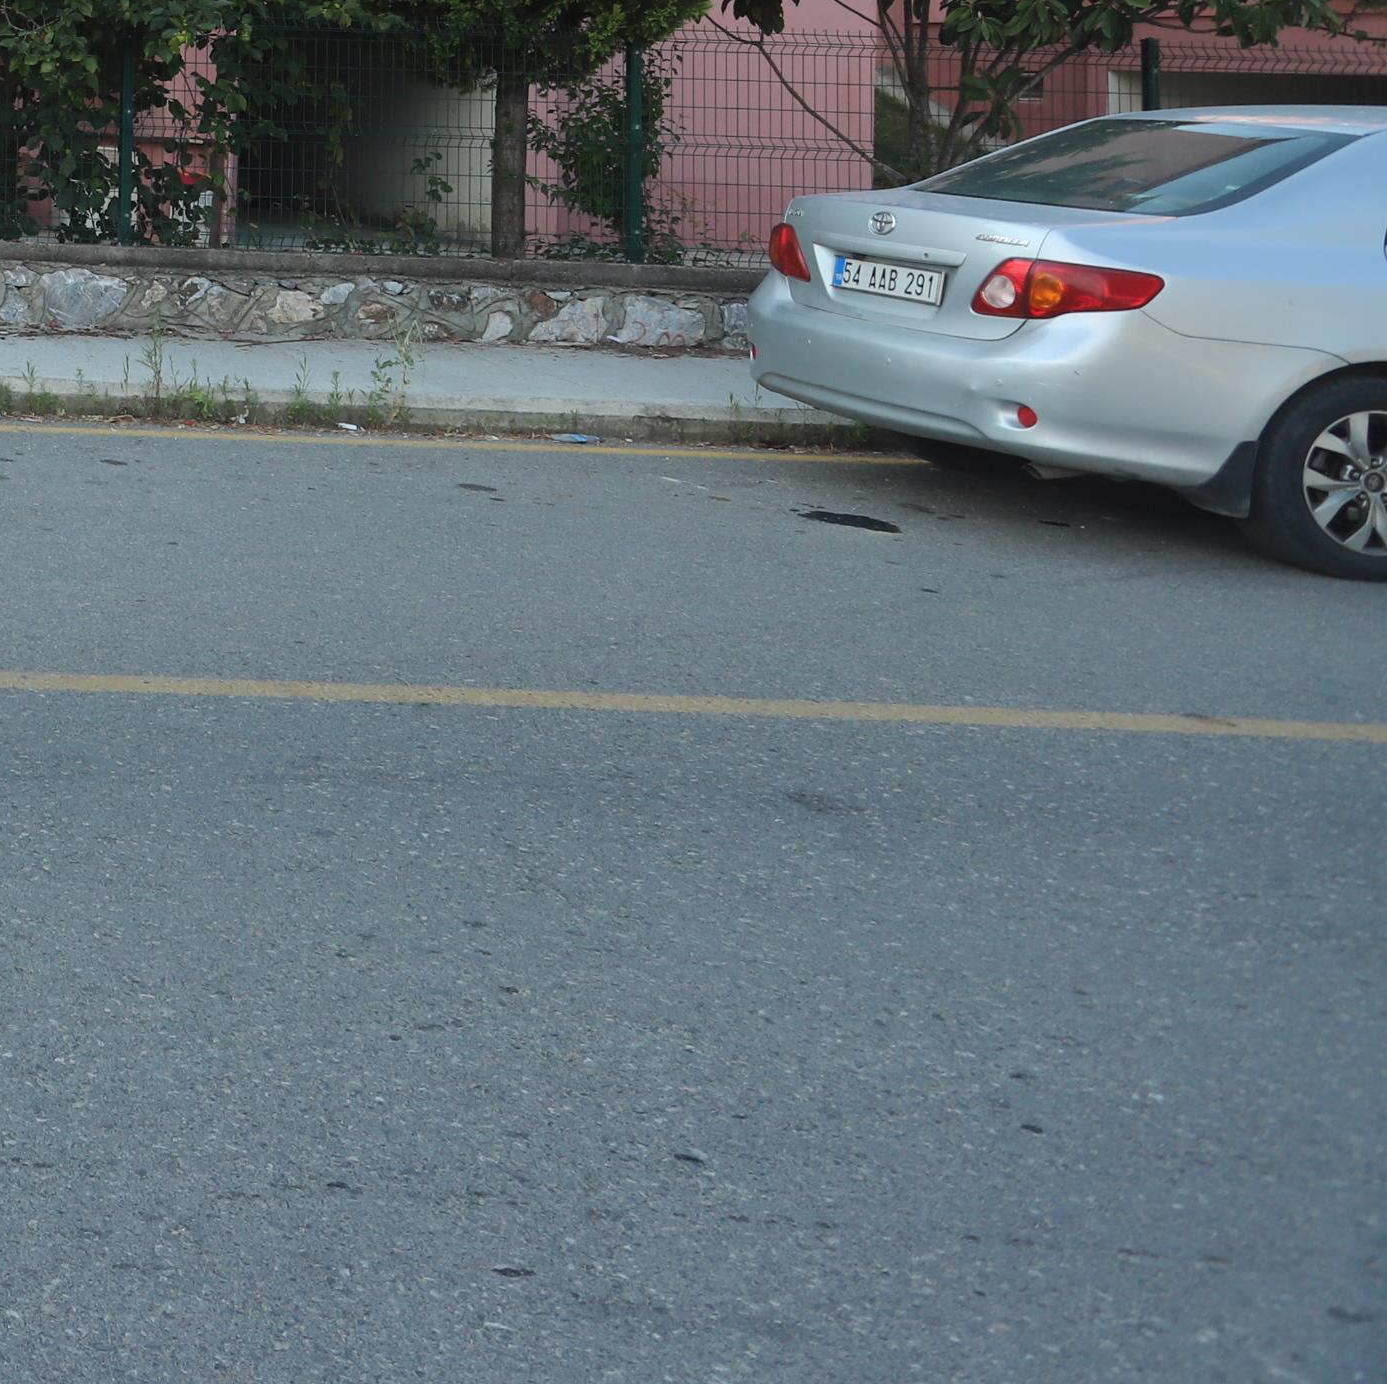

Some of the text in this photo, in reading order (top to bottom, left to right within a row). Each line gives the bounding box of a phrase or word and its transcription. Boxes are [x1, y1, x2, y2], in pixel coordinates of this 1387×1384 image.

[843, 262, 862, 286] 54
[868, 266, 898, 291] AAB
[904, 272, 933, 298] 291
